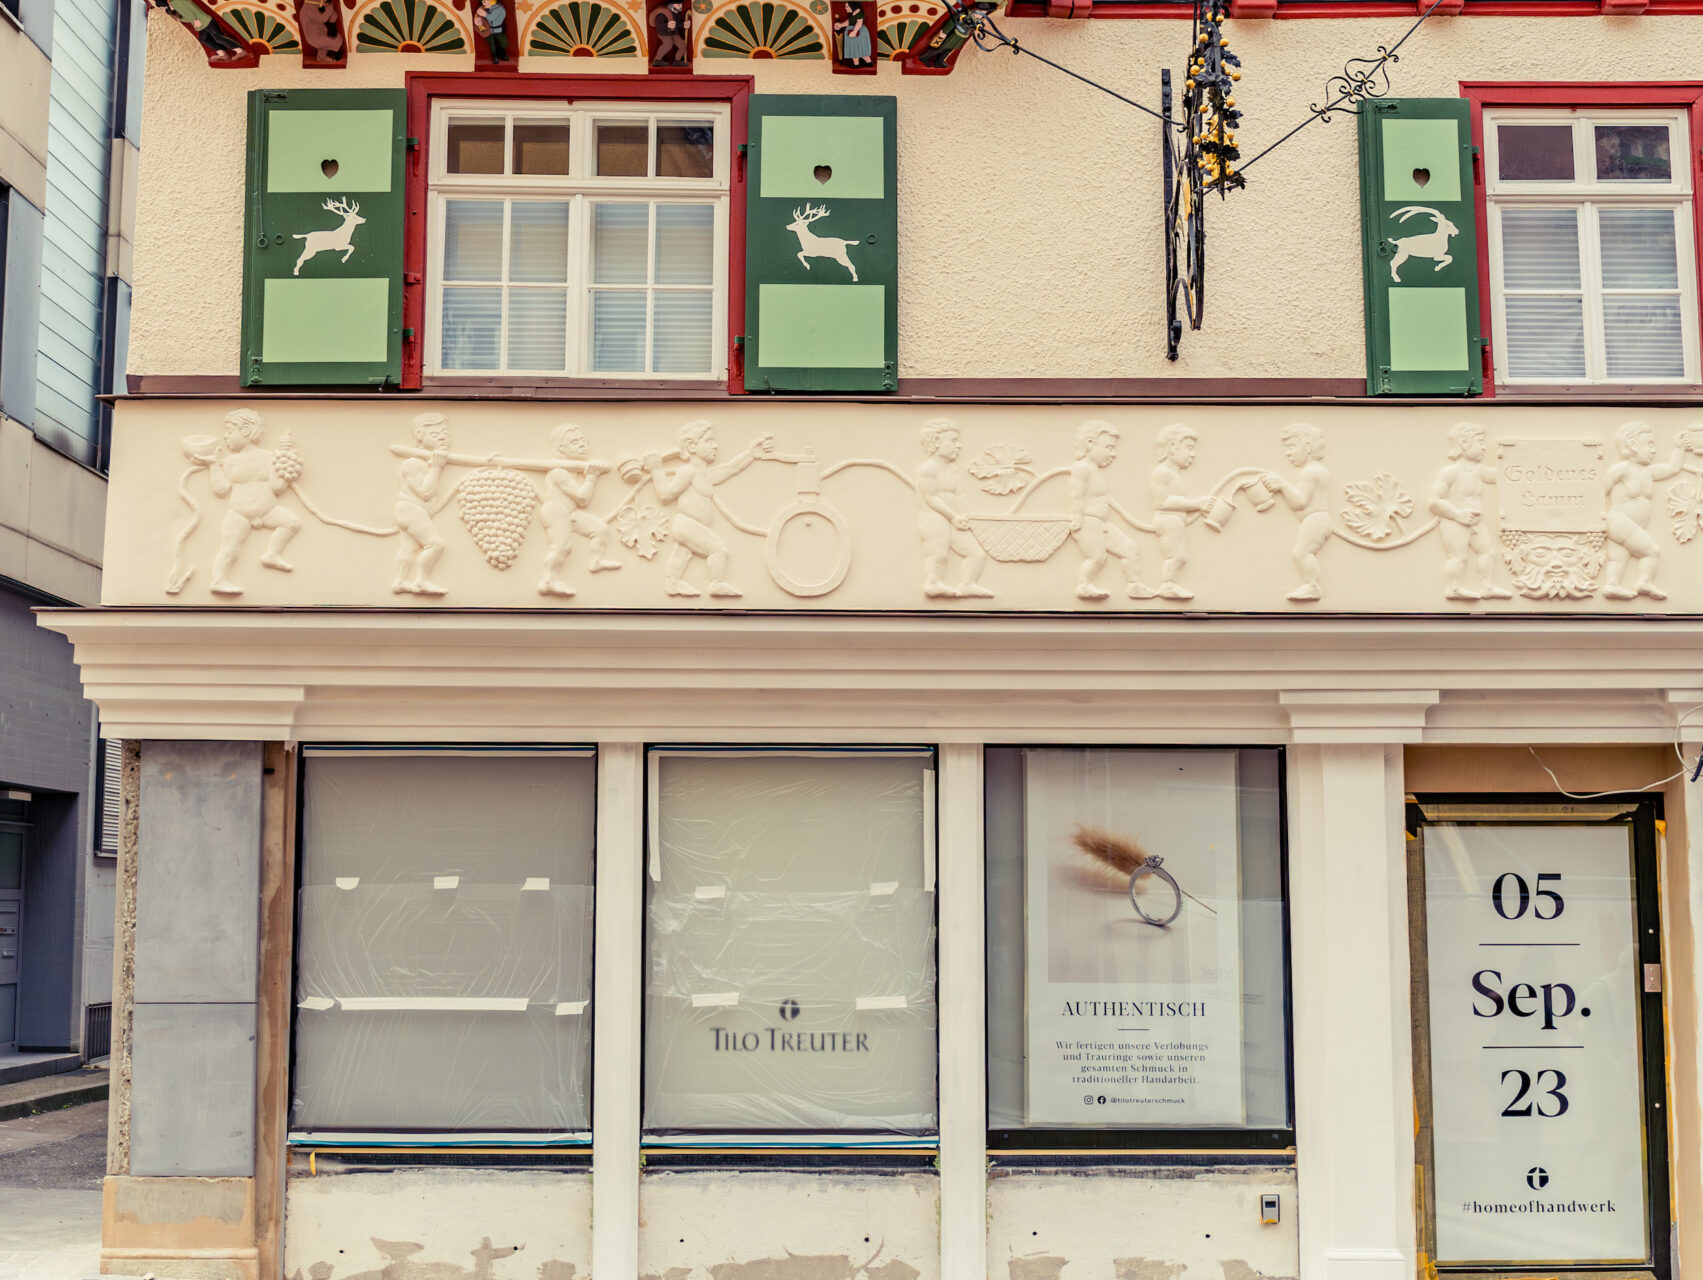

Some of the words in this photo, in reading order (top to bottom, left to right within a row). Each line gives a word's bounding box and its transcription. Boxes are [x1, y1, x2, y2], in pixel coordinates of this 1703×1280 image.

[1504, 465, 1598, 482] Goldenes
[1491, 872, 1565, 920] 05
[1471, 969, 1592, 1030] Sep.
[1061, 1001, 1206, 1017] AUTHENTISCH
[709, 1028, 760, 1052] TILO
[765, 1028, 870, 1052] TREUTER
[1055, 1041, 1073, 1050] Wir
[1076, 1041, 1115, 1052] fertigen
[1118, 1042, 1151, 1050] unsere
[1154, 1041, 1209, 1052] Verlobungs
[1063, 1052, 1082, 1061] und
[1084, 1053, 1134, 1063] Trauringe
[1136, 1053, 1164, 1061] sowie
[1167, 1054, 1206, 1062] unseren
[1080, 1064, 1127, 1074] gesamten
[1130, 1064, 1175, 1072] Schmuck
[1178, 1064, 1188, 1072] in
[1072, 1075, 1139, 1084] traditioneller
[1141, 1075, 1200, 1084] Handarbeit.
[1500, 1069, 1570, 1118] 23
[1462, 1200, 1617, 1214] #homeofhandwerk
